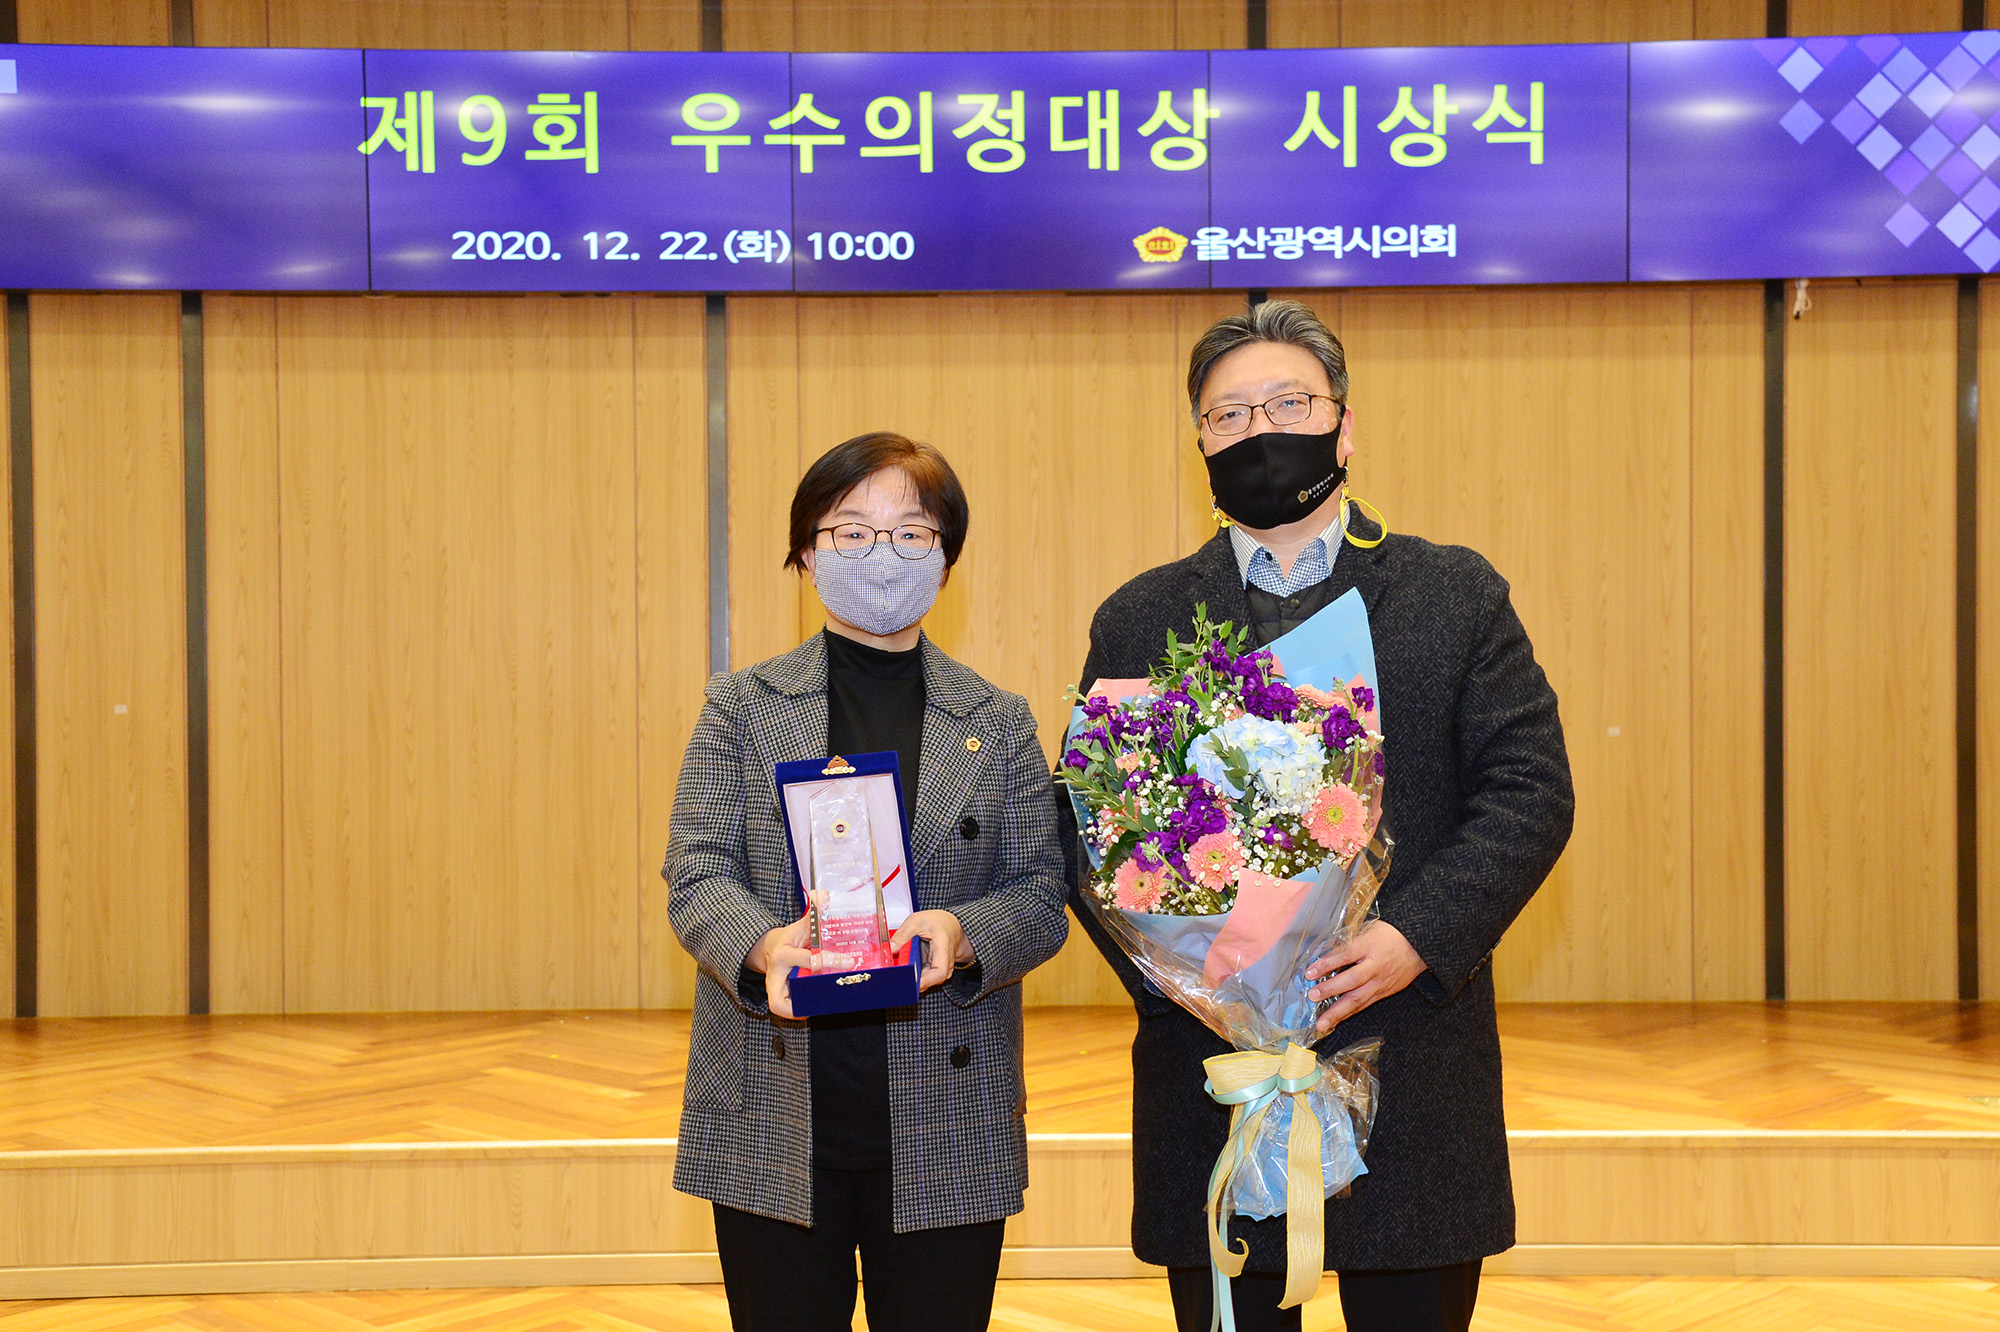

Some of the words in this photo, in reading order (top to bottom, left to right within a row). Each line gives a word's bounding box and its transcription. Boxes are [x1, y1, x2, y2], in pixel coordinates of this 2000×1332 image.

[357, 90, 599, 174] 제9회
[671, 88, 1221, 174] 우수의정대상
[1284, 81, 1544, 168] 시상식
[451, 230, 562, 261] 2020.
[582, 230, 641, 261] 12.
[807, 230, 915, 261] 10:00
[1190, 223, 1457, 261] 울산광역시의회
